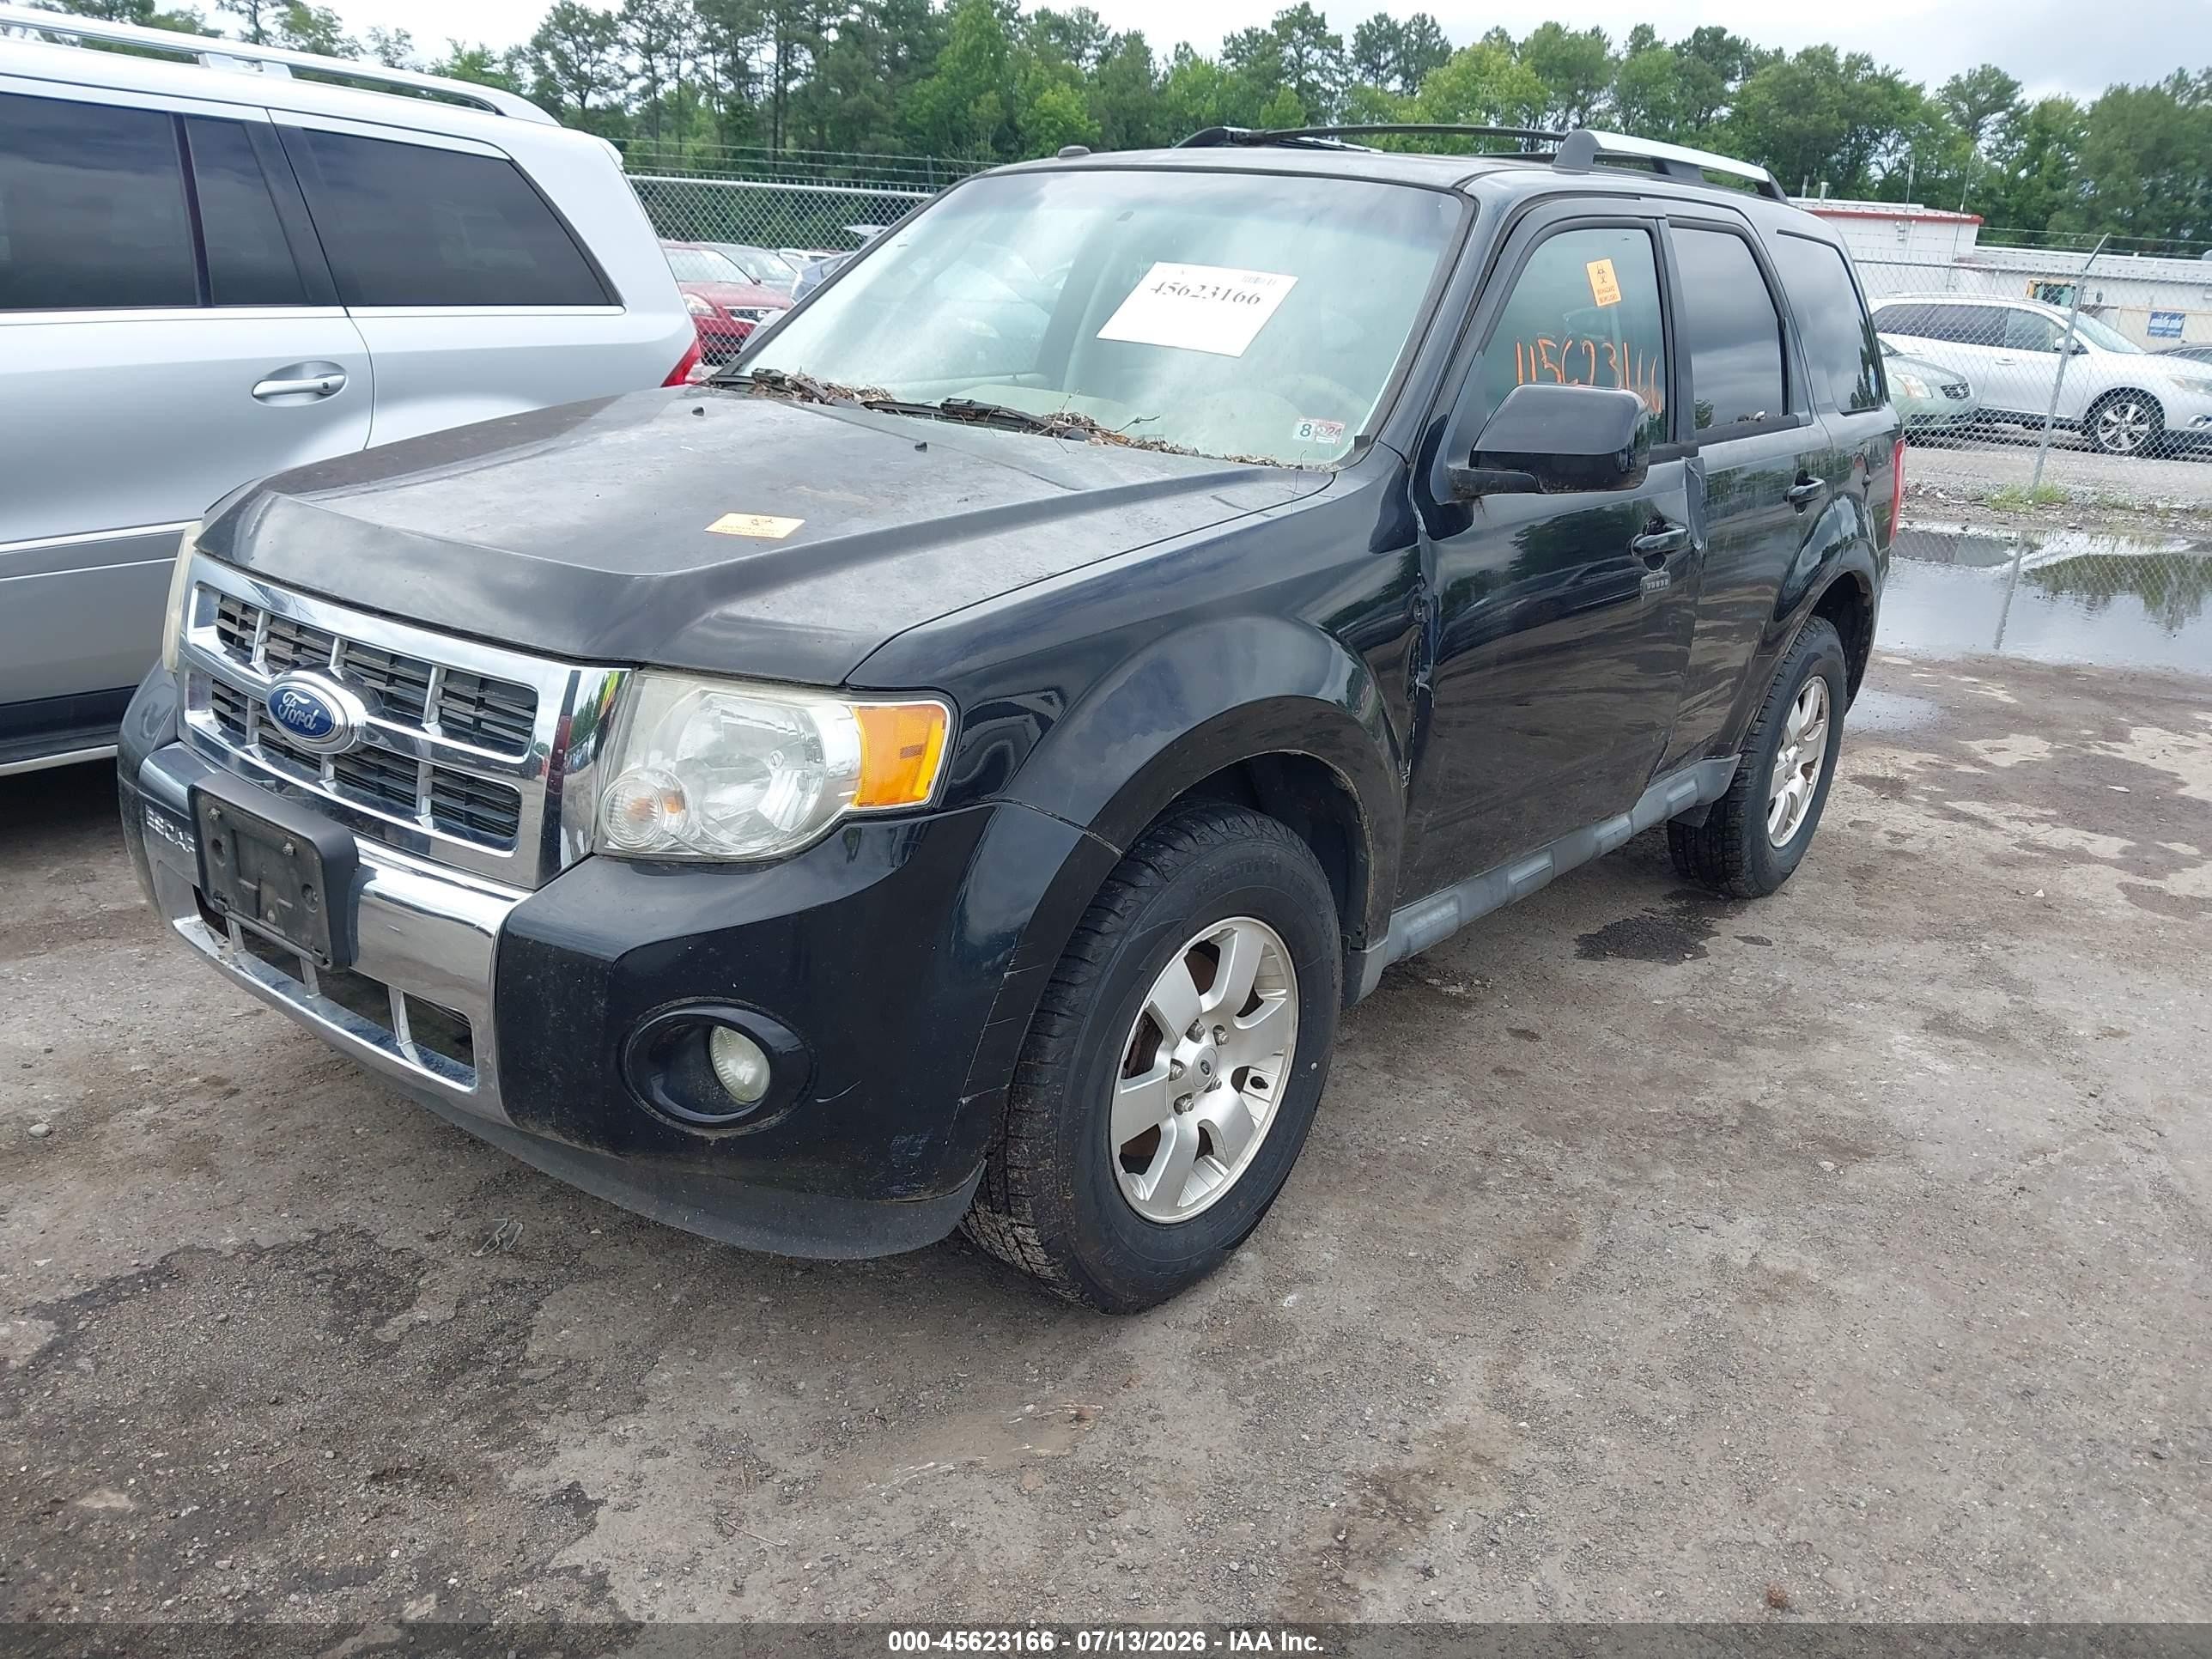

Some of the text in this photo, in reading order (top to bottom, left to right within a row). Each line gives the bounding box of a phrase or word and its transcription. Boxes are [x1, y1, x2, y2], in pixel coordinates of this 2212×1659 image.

[1150, 281, 1261, 305] 45623166
[1299, 422, 1312, 437] 8
[277, 691, 319, 731] Ford
[144, 804, 196, 853] ESCAP
